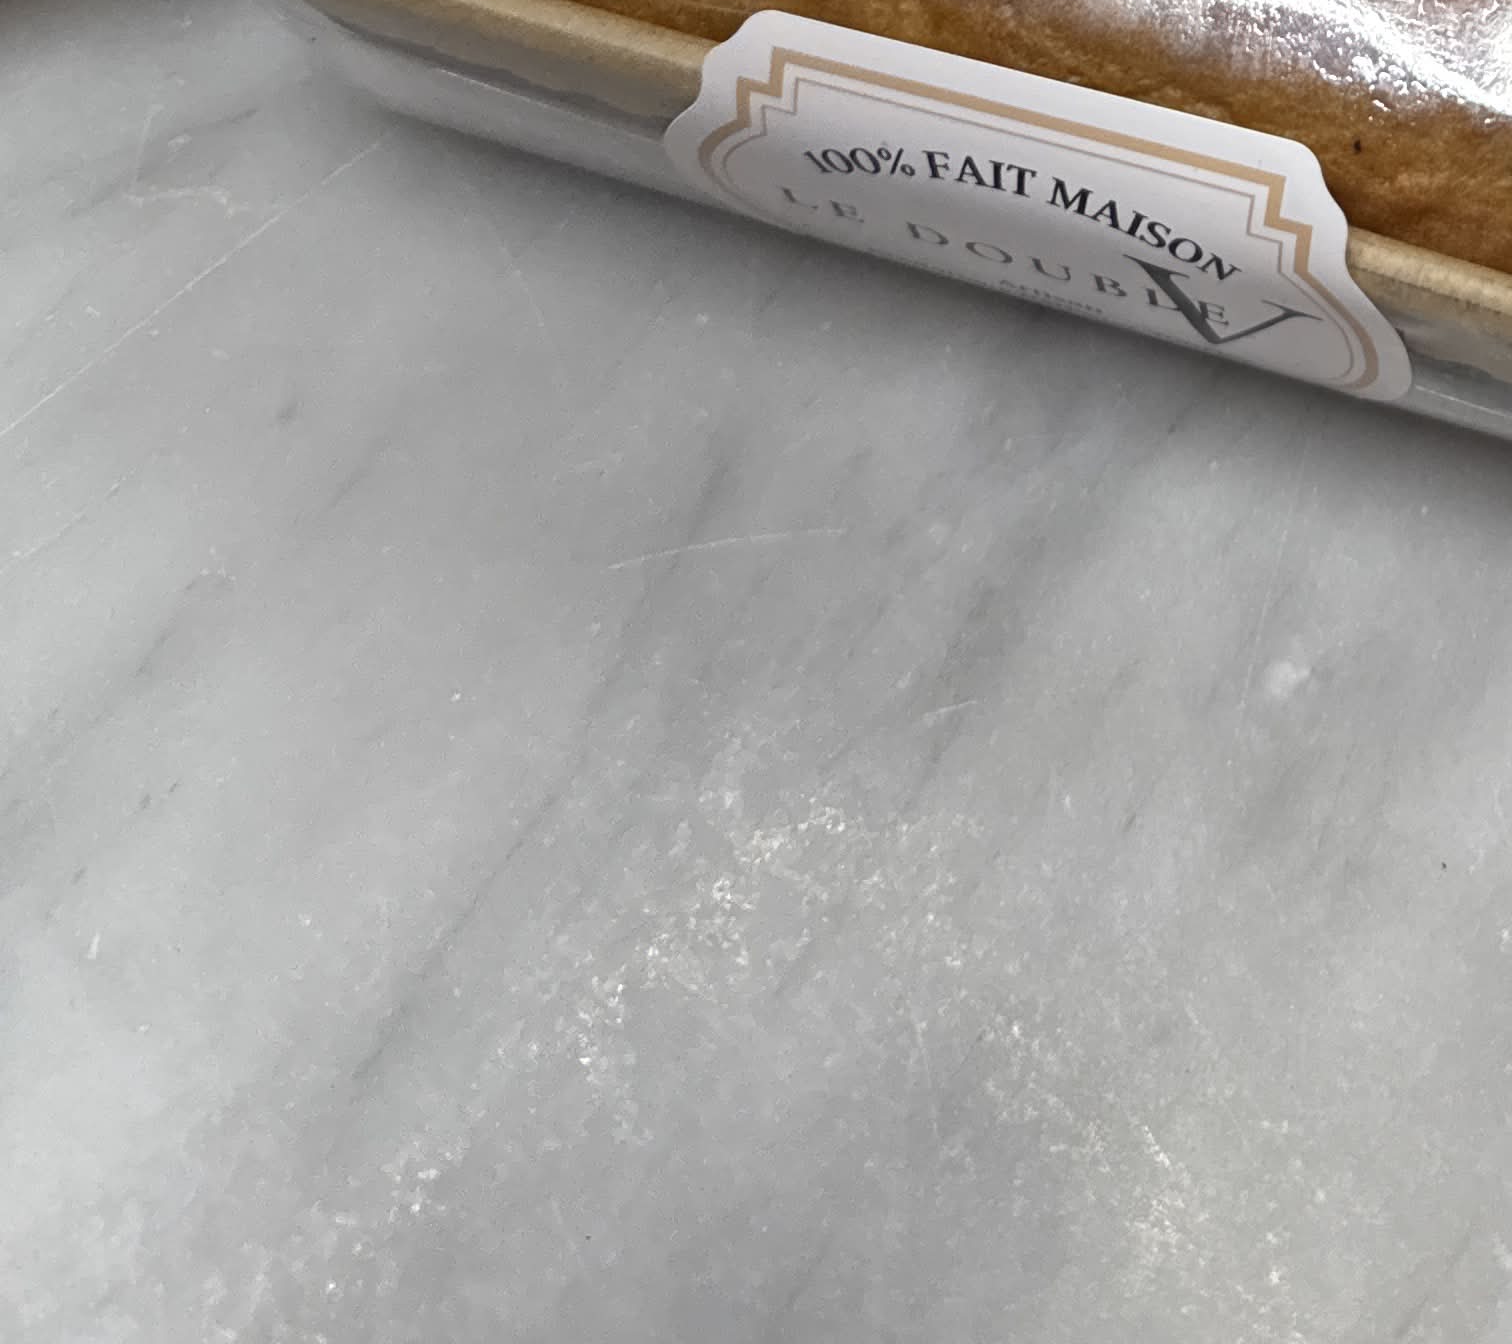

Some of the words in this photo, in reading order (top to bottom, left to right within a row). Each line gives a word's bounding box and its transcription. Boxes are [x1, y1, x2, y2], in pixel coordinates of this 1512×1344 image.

[780, 185, 865, 224] LE
[906, 221, 1230, 326] DOUBLE
[803, 146, 916, 179] 100%
[922, 149, 1038, 198] FAIT
[1049, 177, 1243, 282] MAISON
